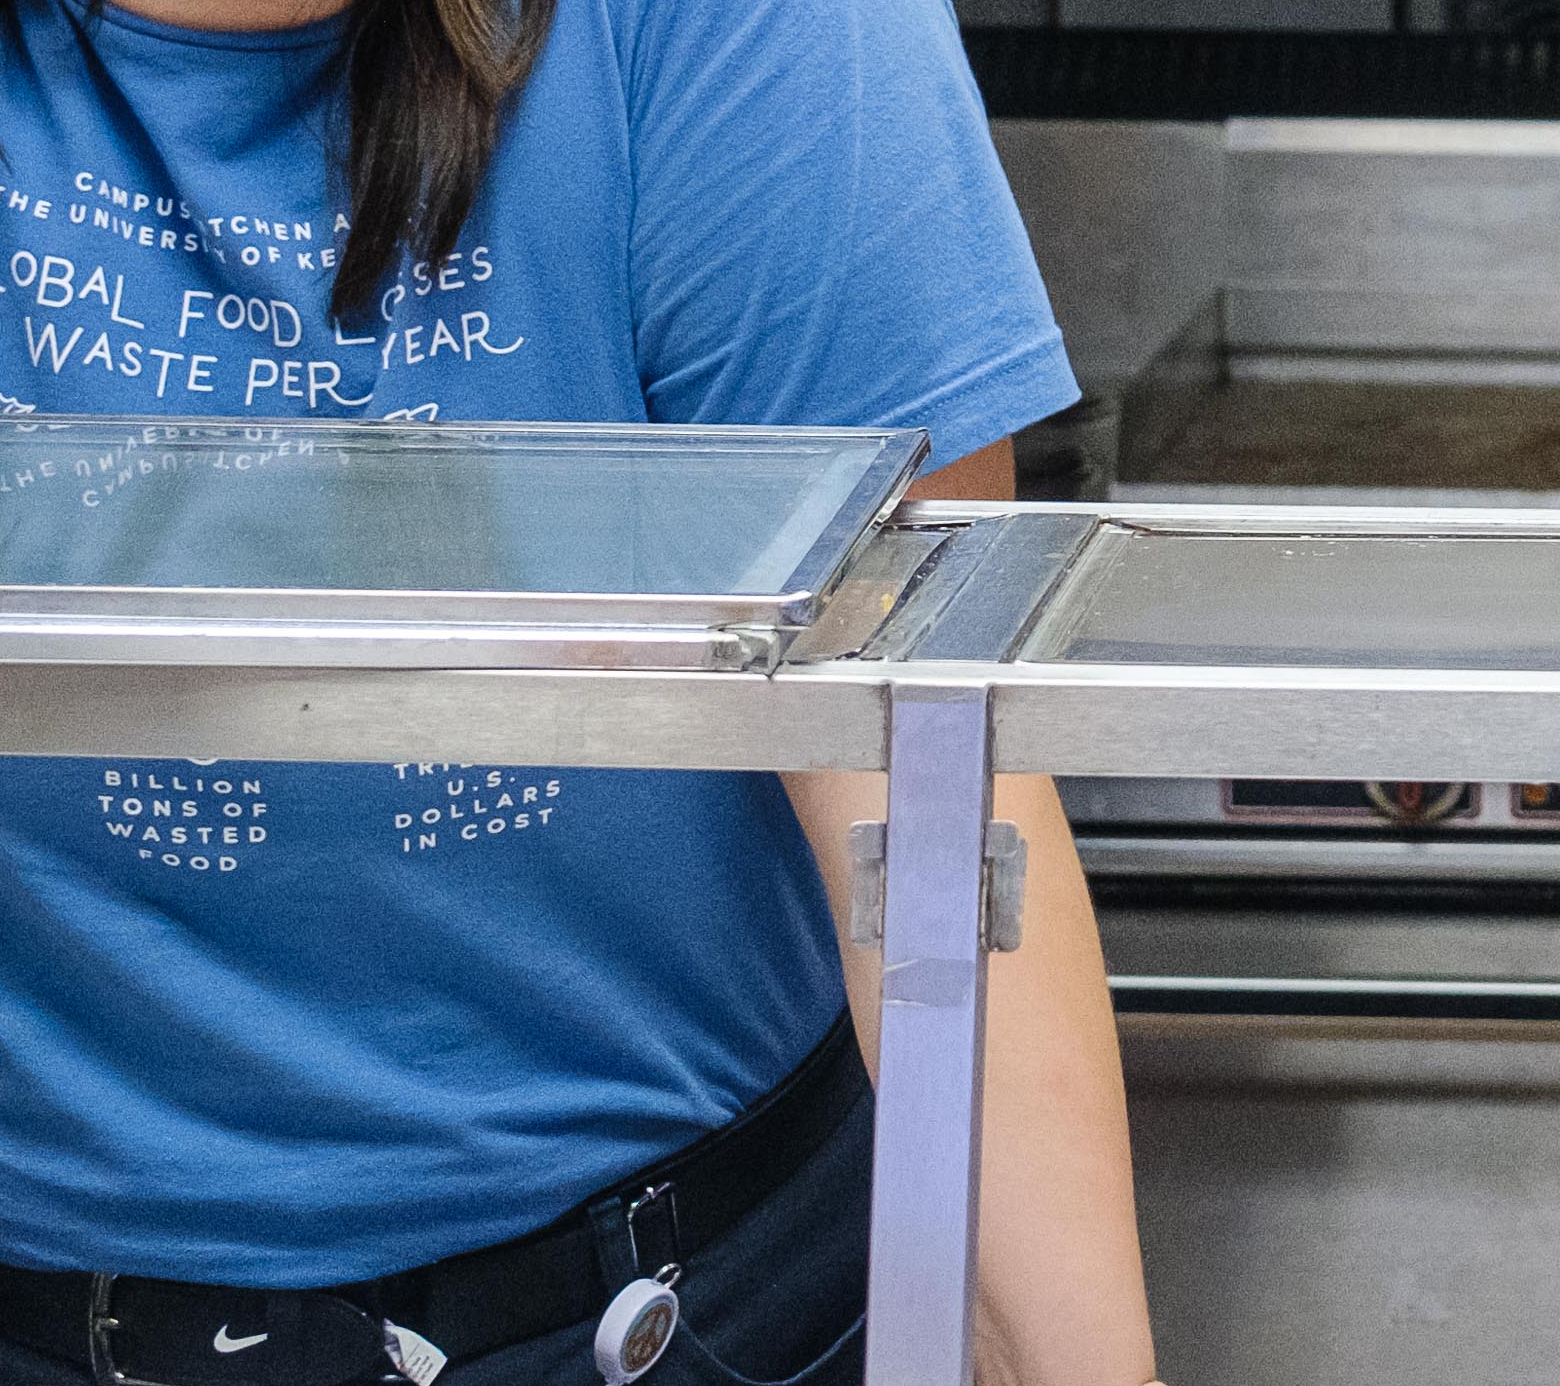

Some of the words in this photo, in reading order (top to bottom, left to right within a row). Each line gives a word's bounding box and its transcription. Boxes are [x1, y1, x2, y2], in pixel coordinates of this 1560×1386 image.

[74, 172, 192, 220] CAMPUS
[200, 213, 313, 241] TCHEN
[241, 246, 282, 267] OF
[178, 289, 302, 349] FOOD
[25, 315, 218, 399] WASTE
[244, 357, 374, 409] PER
[381, 310, 525, 371] YEAR
[104, 770, 261, 795] BILLION
[447, 770, 516, 797] U.S.
[97, 795, 199, 818] TONS
[223, 802, 268, 819] OF
[394, 779, 561, 830] DOLLARS
[95, 821, 268, 845] WASTED
[402, 832, 438, 853] IN
[461, 807, 554, 841] COST
[139, 849, 239, 873] FOOD
